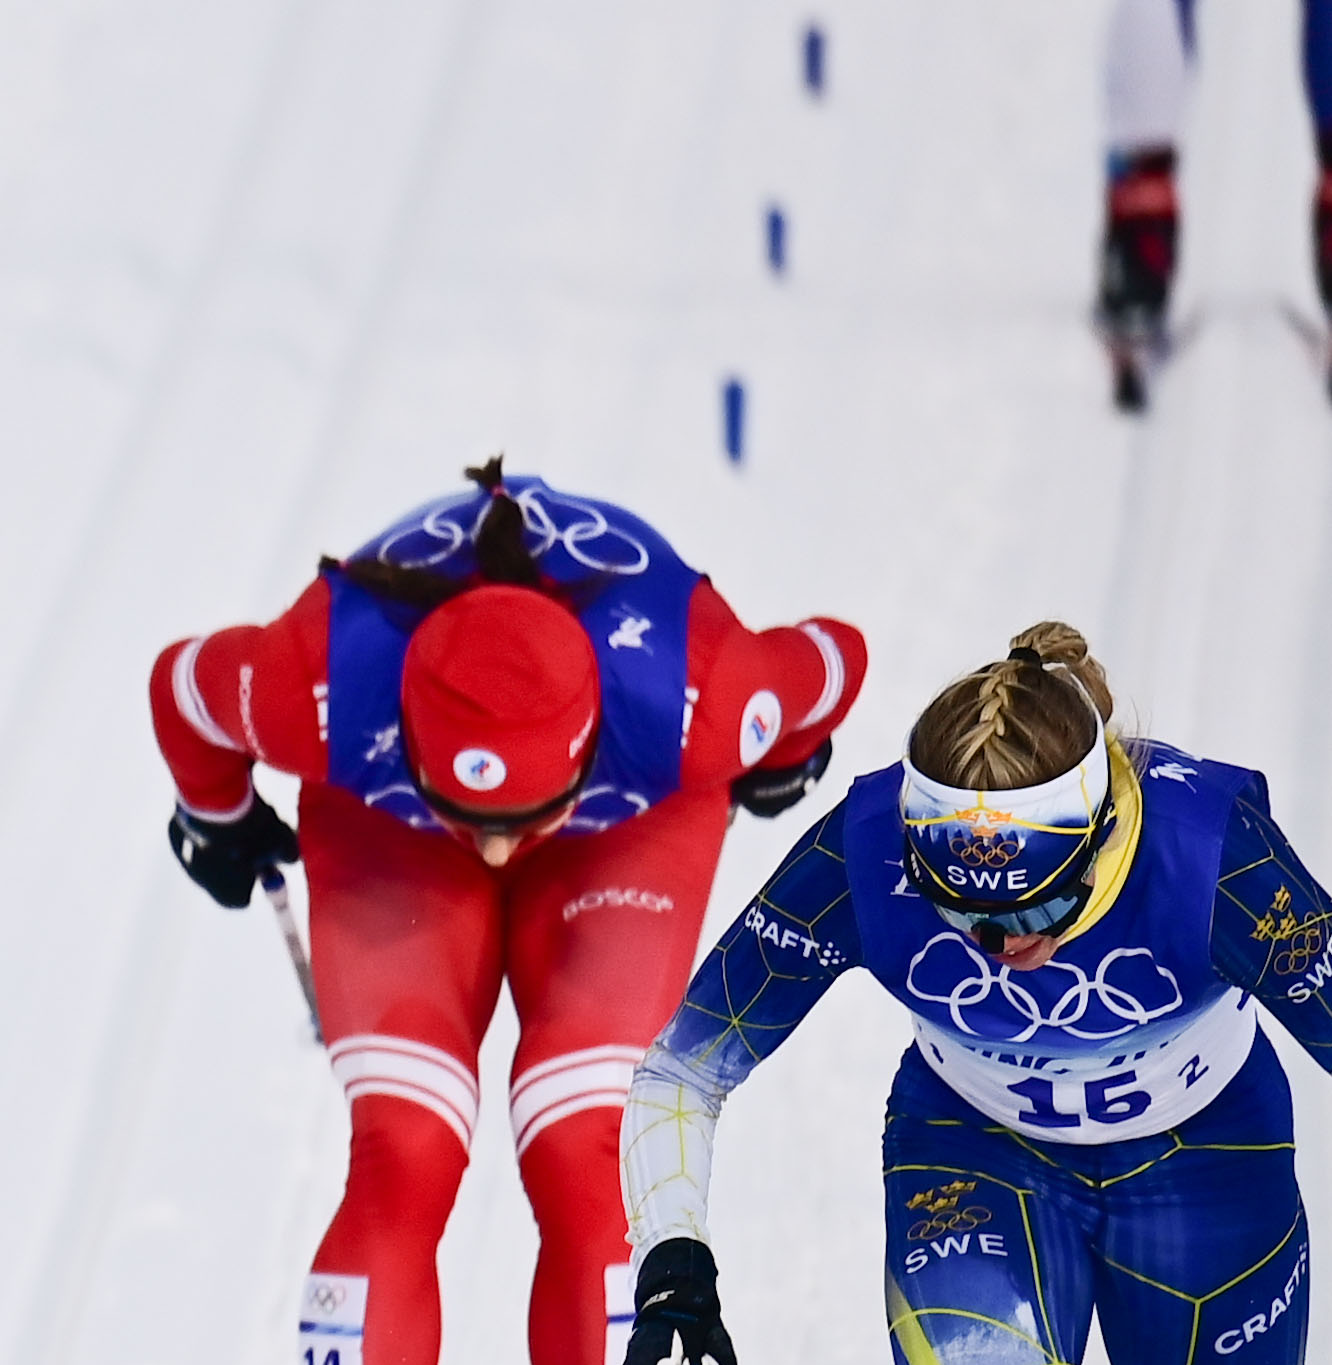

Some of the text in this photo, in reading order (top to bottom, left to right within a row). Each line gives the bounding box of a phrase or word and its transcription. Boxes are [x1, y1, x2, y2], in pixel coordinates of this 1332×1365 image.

[946, 864, 1029, 891] SWE
[744, 906, 821, 959] CRAFT
[1287, 935, 1332, 1004] SW
[1007, 1069, 1153, 1128] 15
[1177, 1054, 1210, 1089] 2
[904, 1233, 1008, 1274] SWE
[1214, 1259, 1301, 1355] CRAFT
